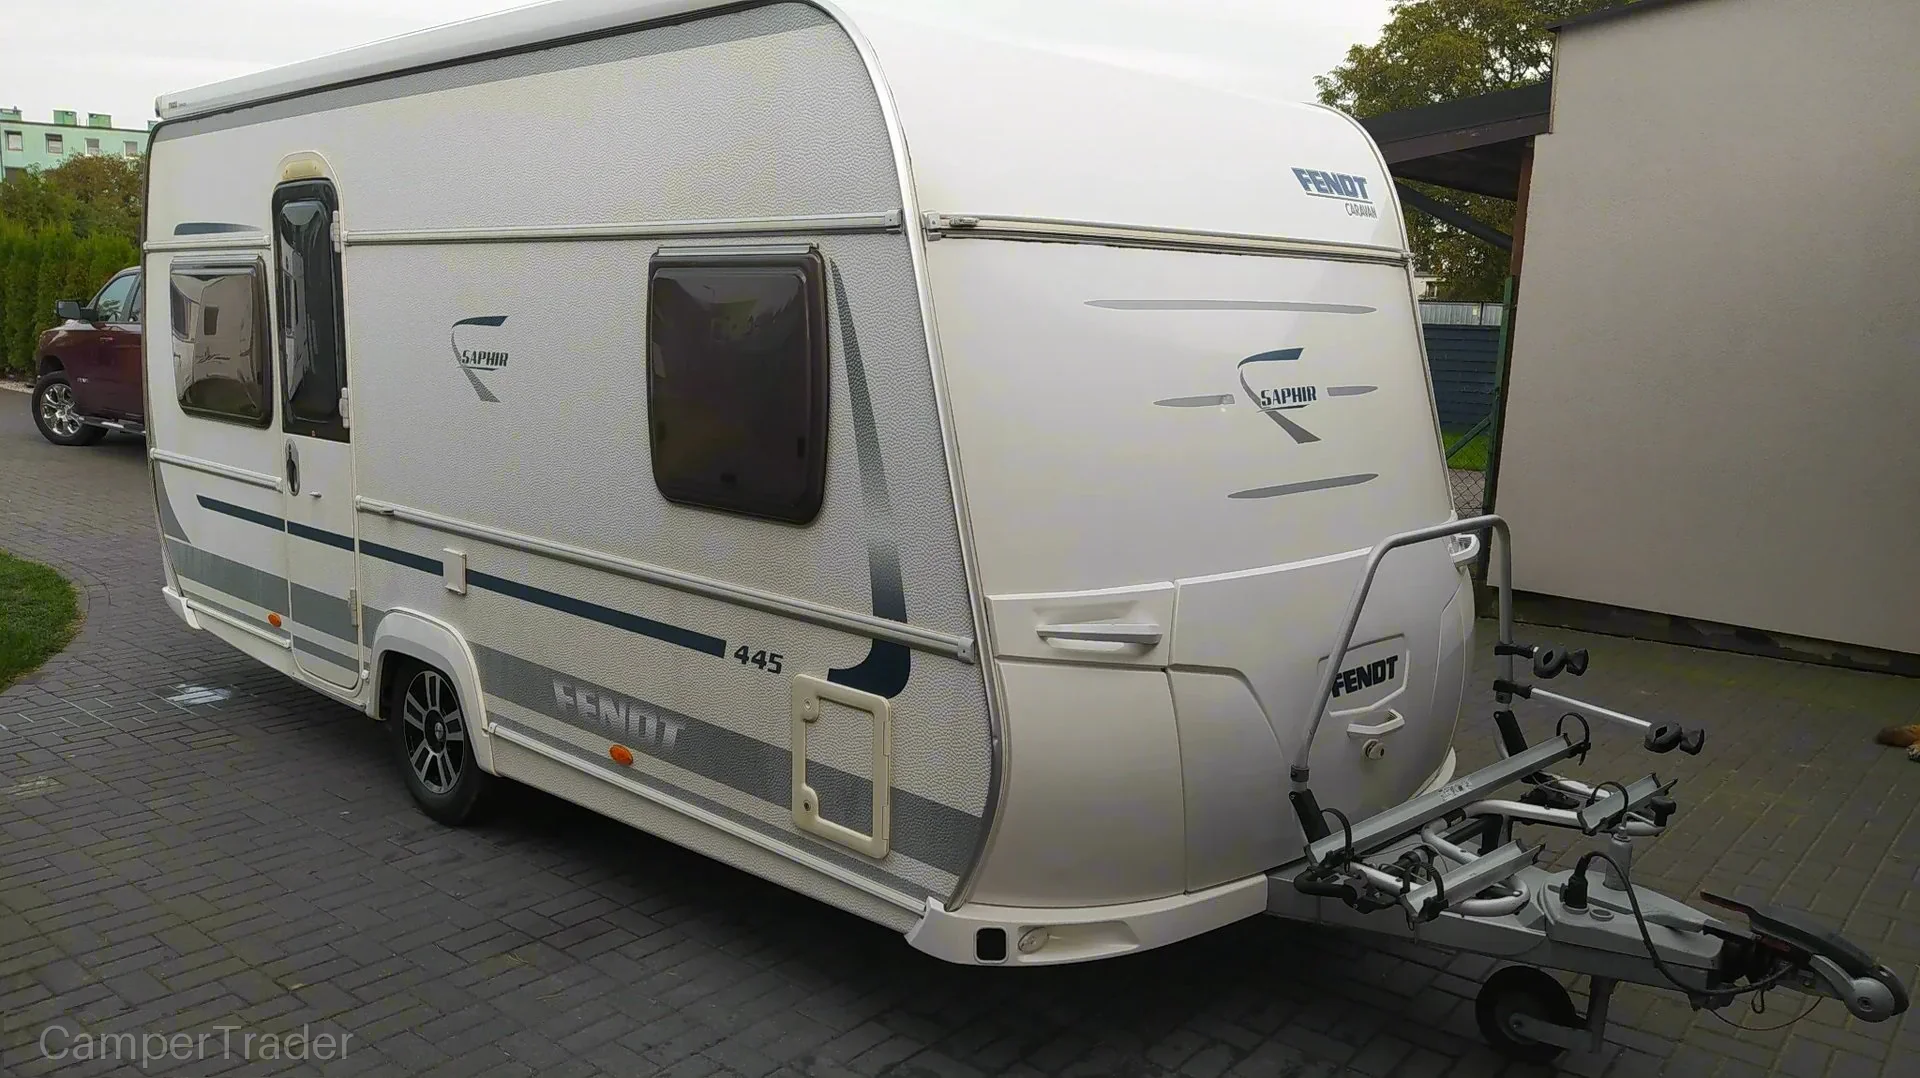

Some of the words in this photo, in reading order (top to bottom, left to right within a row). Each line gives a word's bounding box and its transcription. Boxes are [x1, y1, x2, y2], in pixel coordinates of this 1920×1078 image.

[1291, 167, 1369, 200] FENDT
[1345, 202, 1377, 219] CARAVAN
[461, 350, 509, 367] SAPHIR
[1260, 385, 1317, 406] SAPHIR
[733, 645, 784, 675] 445
[1331, 654, 1399, 698] FENDT
[553, 679, 686, 751] FENDT
